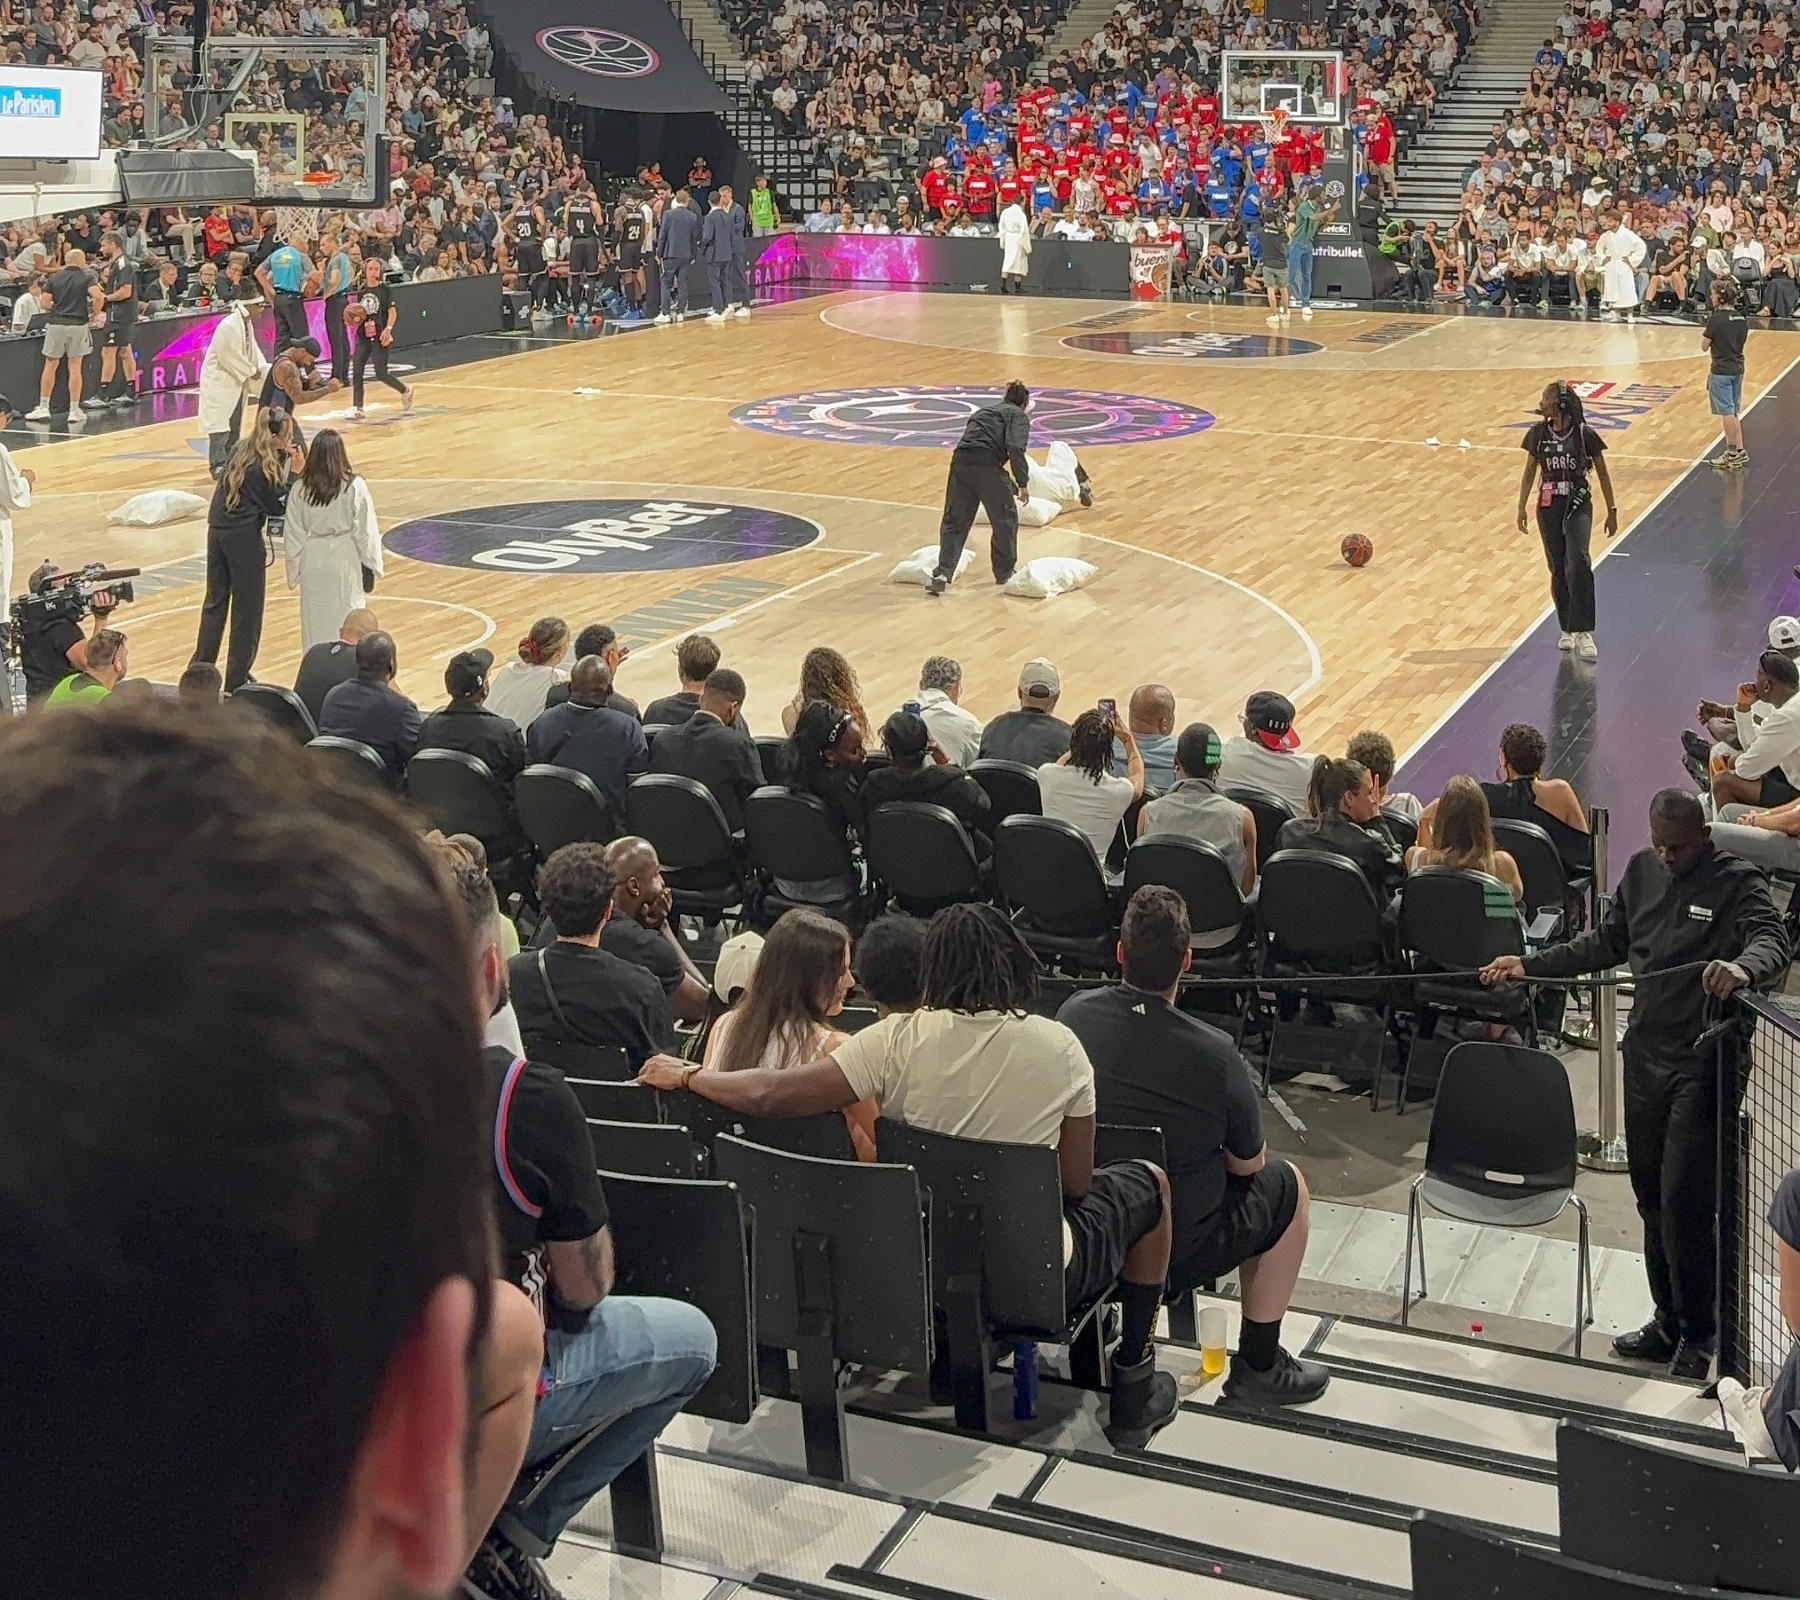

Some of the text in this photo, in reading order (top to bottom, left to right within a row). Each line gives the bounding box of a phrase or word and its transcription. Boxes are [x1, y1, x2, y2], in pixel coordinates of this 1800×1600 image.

[13, 90, 56, 116] Parisien
[517, 222, 532, 237] 20
[575, 218, 585, 235] 4
[1134, 252, 1169, 268] bueno
[1546, 452, 1578, 472] PARIS
[471, 502, 733, 571] OlyBet
